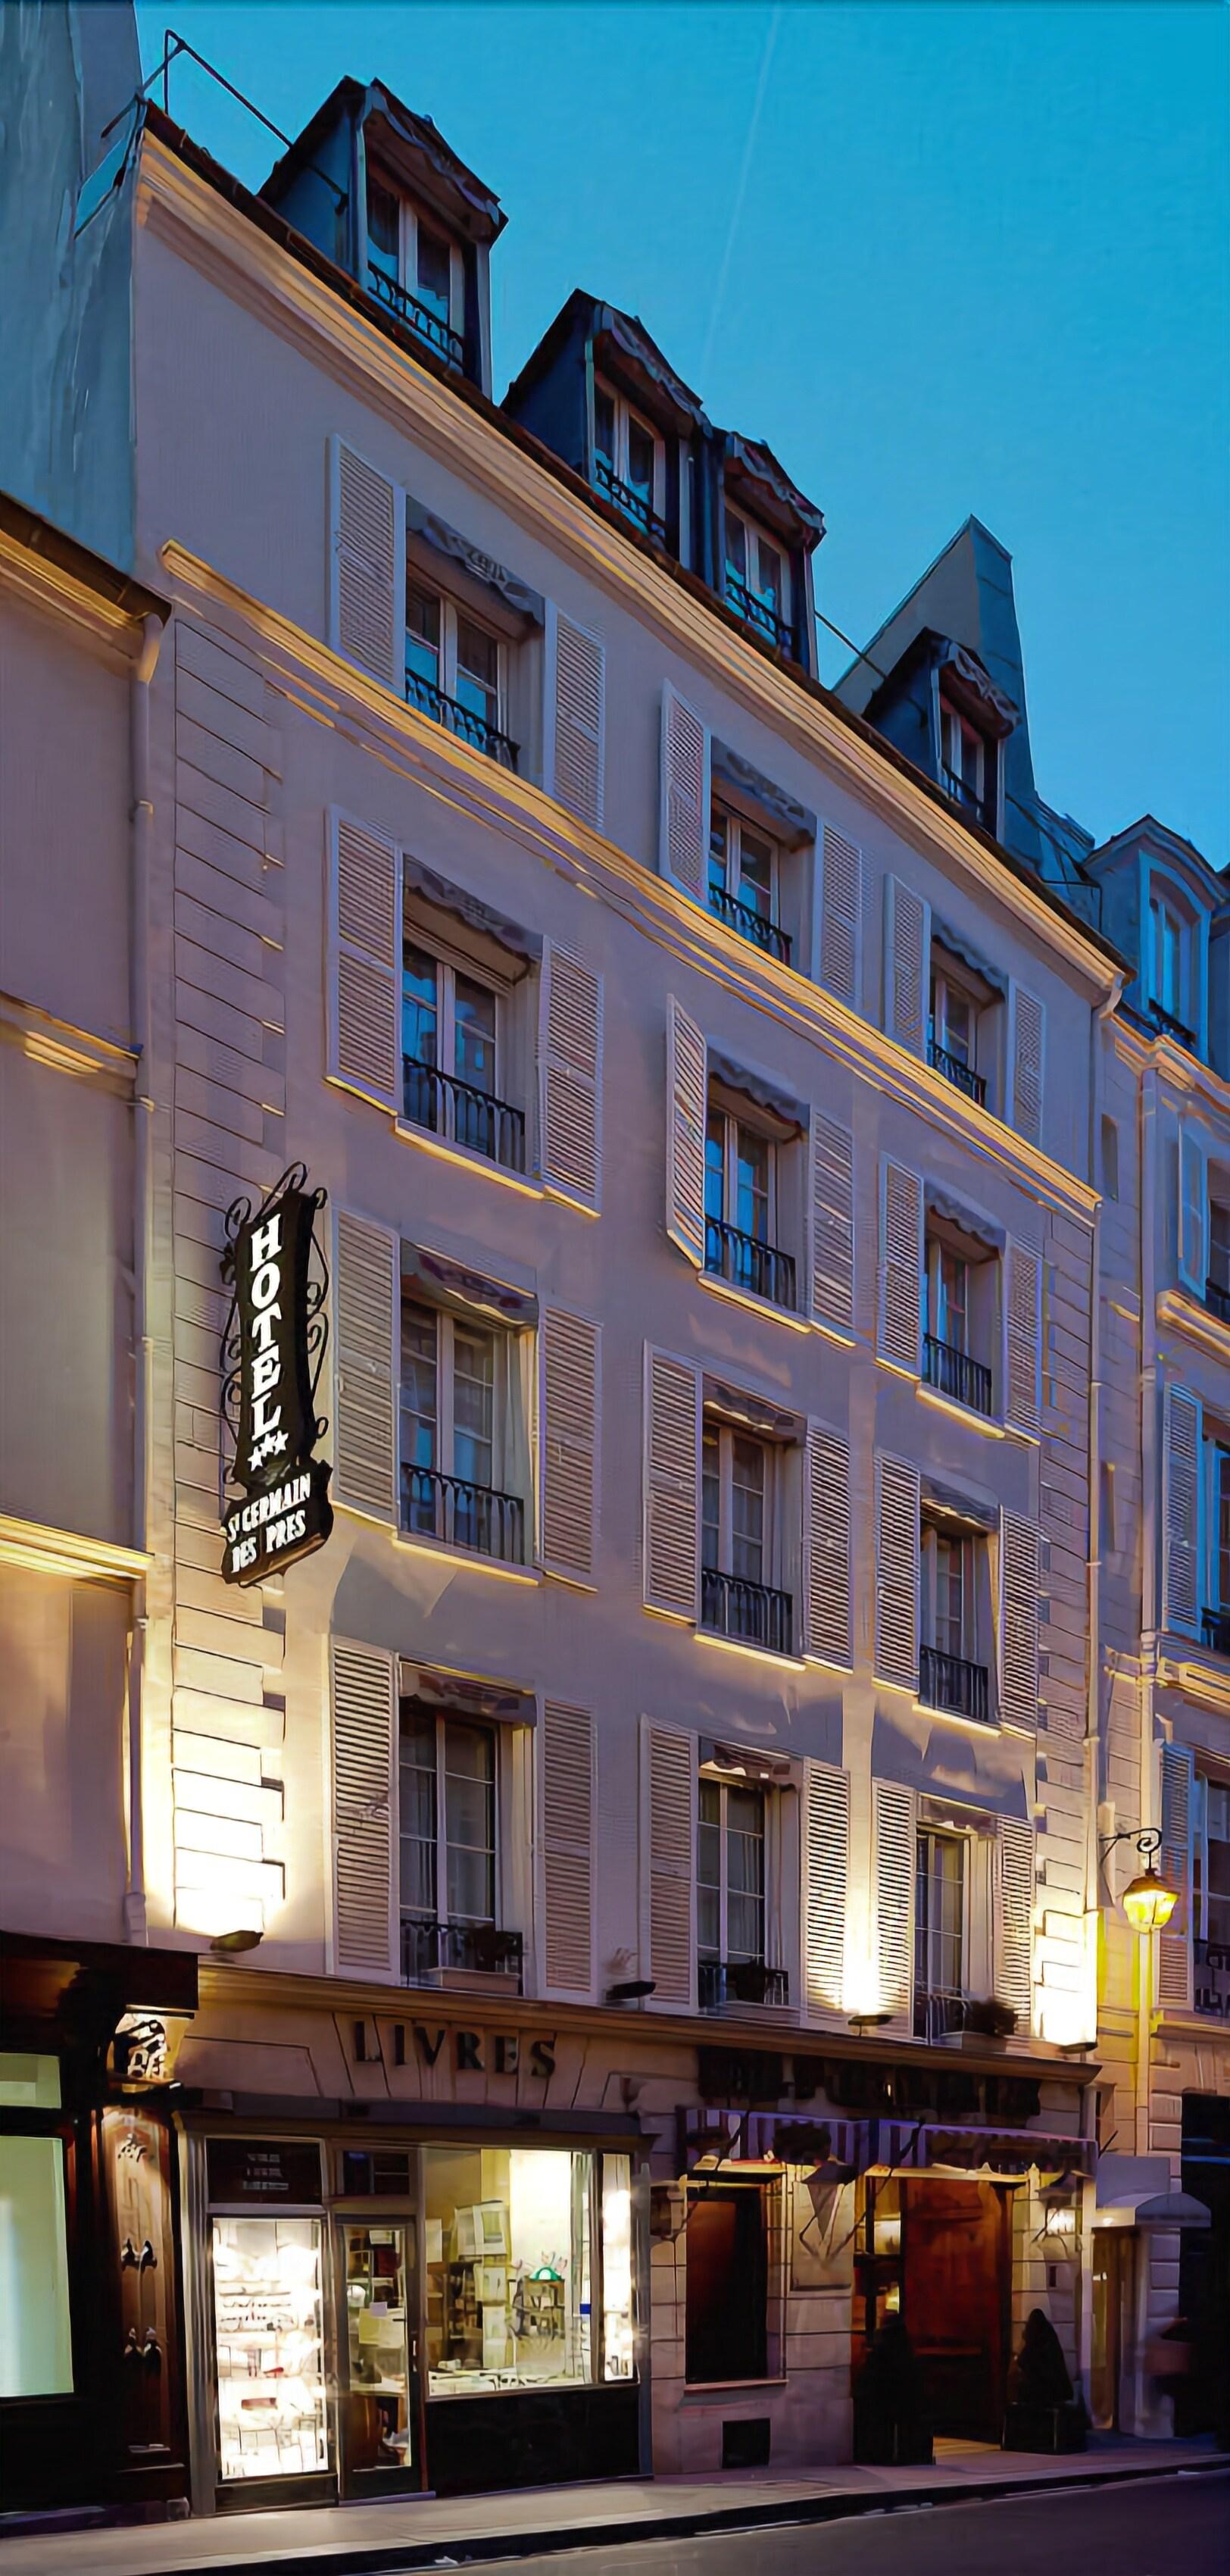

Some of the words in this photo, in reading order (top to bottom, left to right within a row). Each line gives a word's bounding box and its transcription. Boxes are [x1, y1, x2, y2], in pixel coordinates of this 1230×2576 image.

[250, 1213, 283, 1442] HOTEL
[242, 1472, 311, 1532] GERMAIN
[231, 1537, 257, 1574] DES
[266, 1509, 306, 1553] PRES
[353, 2020, 555, 2077] LIVRES
